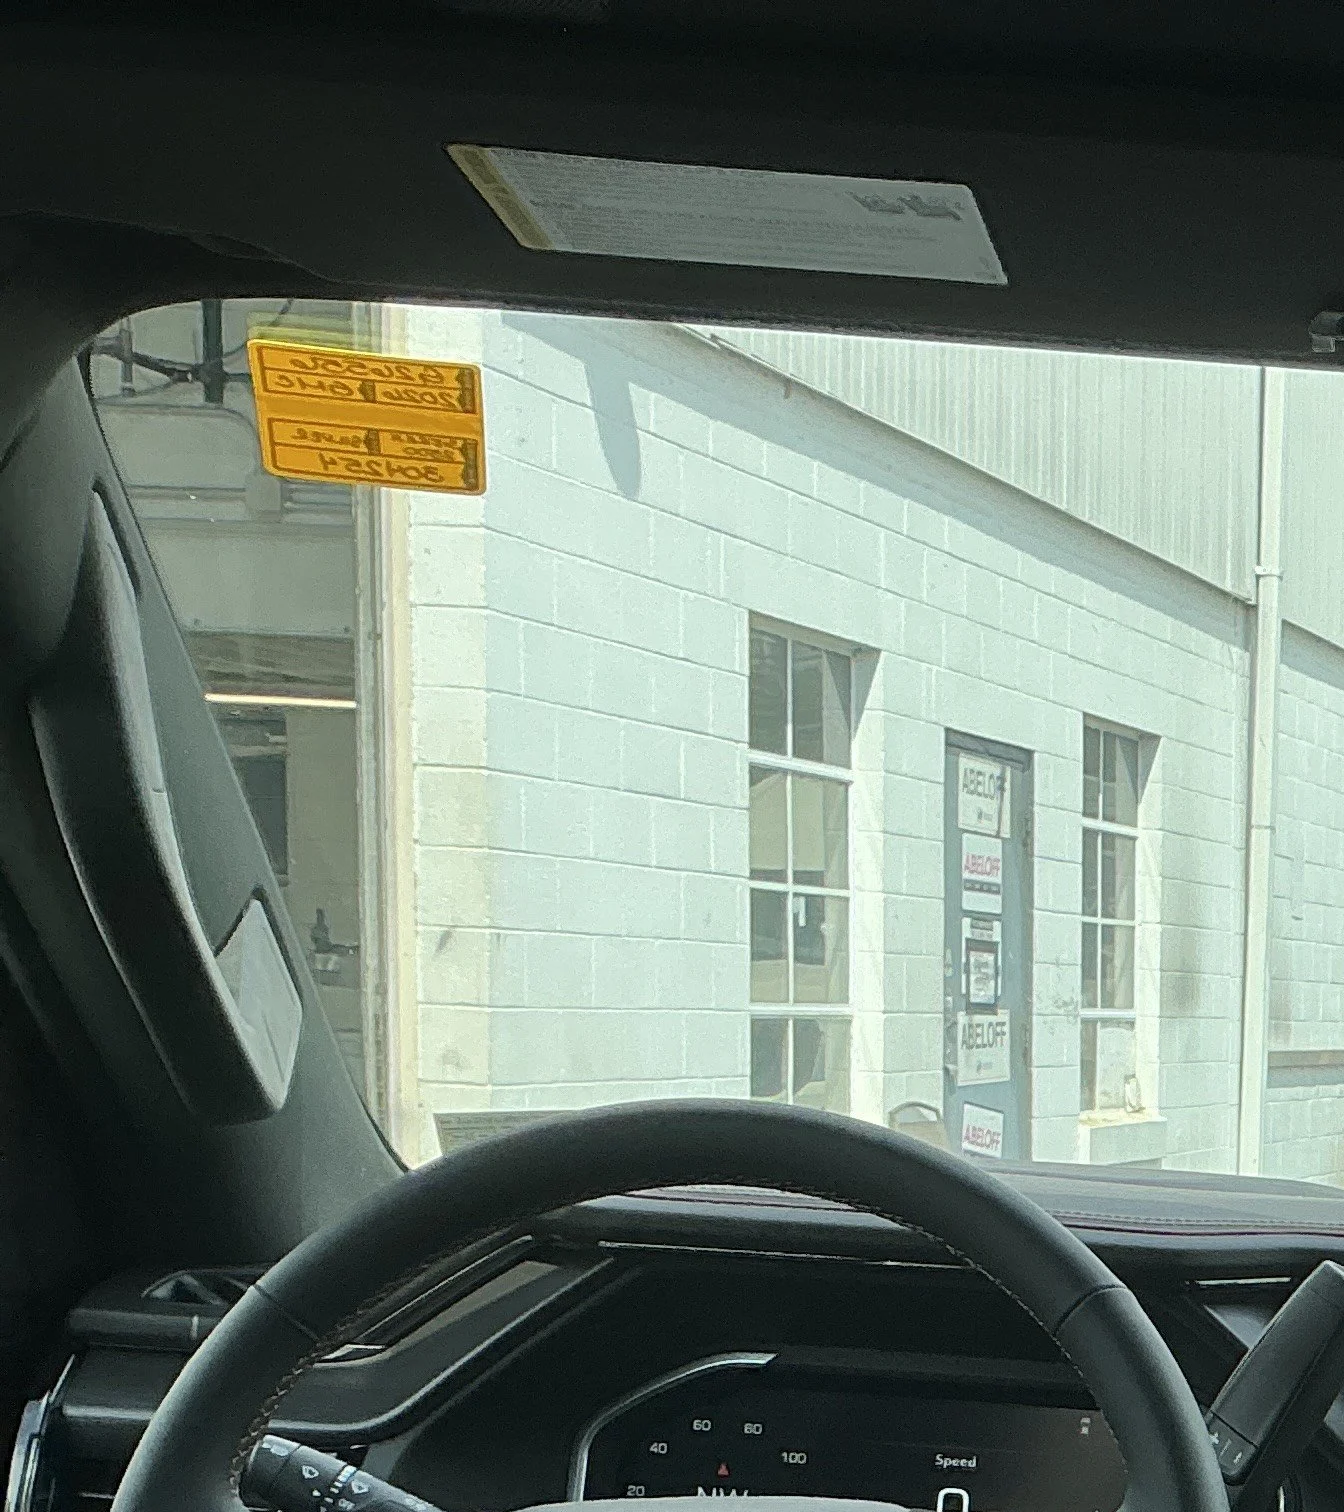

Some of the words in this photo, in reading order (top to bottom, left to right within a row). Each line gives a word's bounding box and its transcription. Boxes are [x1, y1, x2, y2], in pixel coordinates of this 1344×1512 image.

[964, 852, 1001, 877] ABELOFF
[961, 1021, 1006, 1050] ABELOFF
[693, 1419, 711, 1431] 60
[744, 1423, 762, 1434] 80
[650, 1442, 667, 1454] 40
[781, 1452, 807, 1464] 100
[935, 1454, 977, 1469] Speed
[627, 1485, 645, 1496] 20
